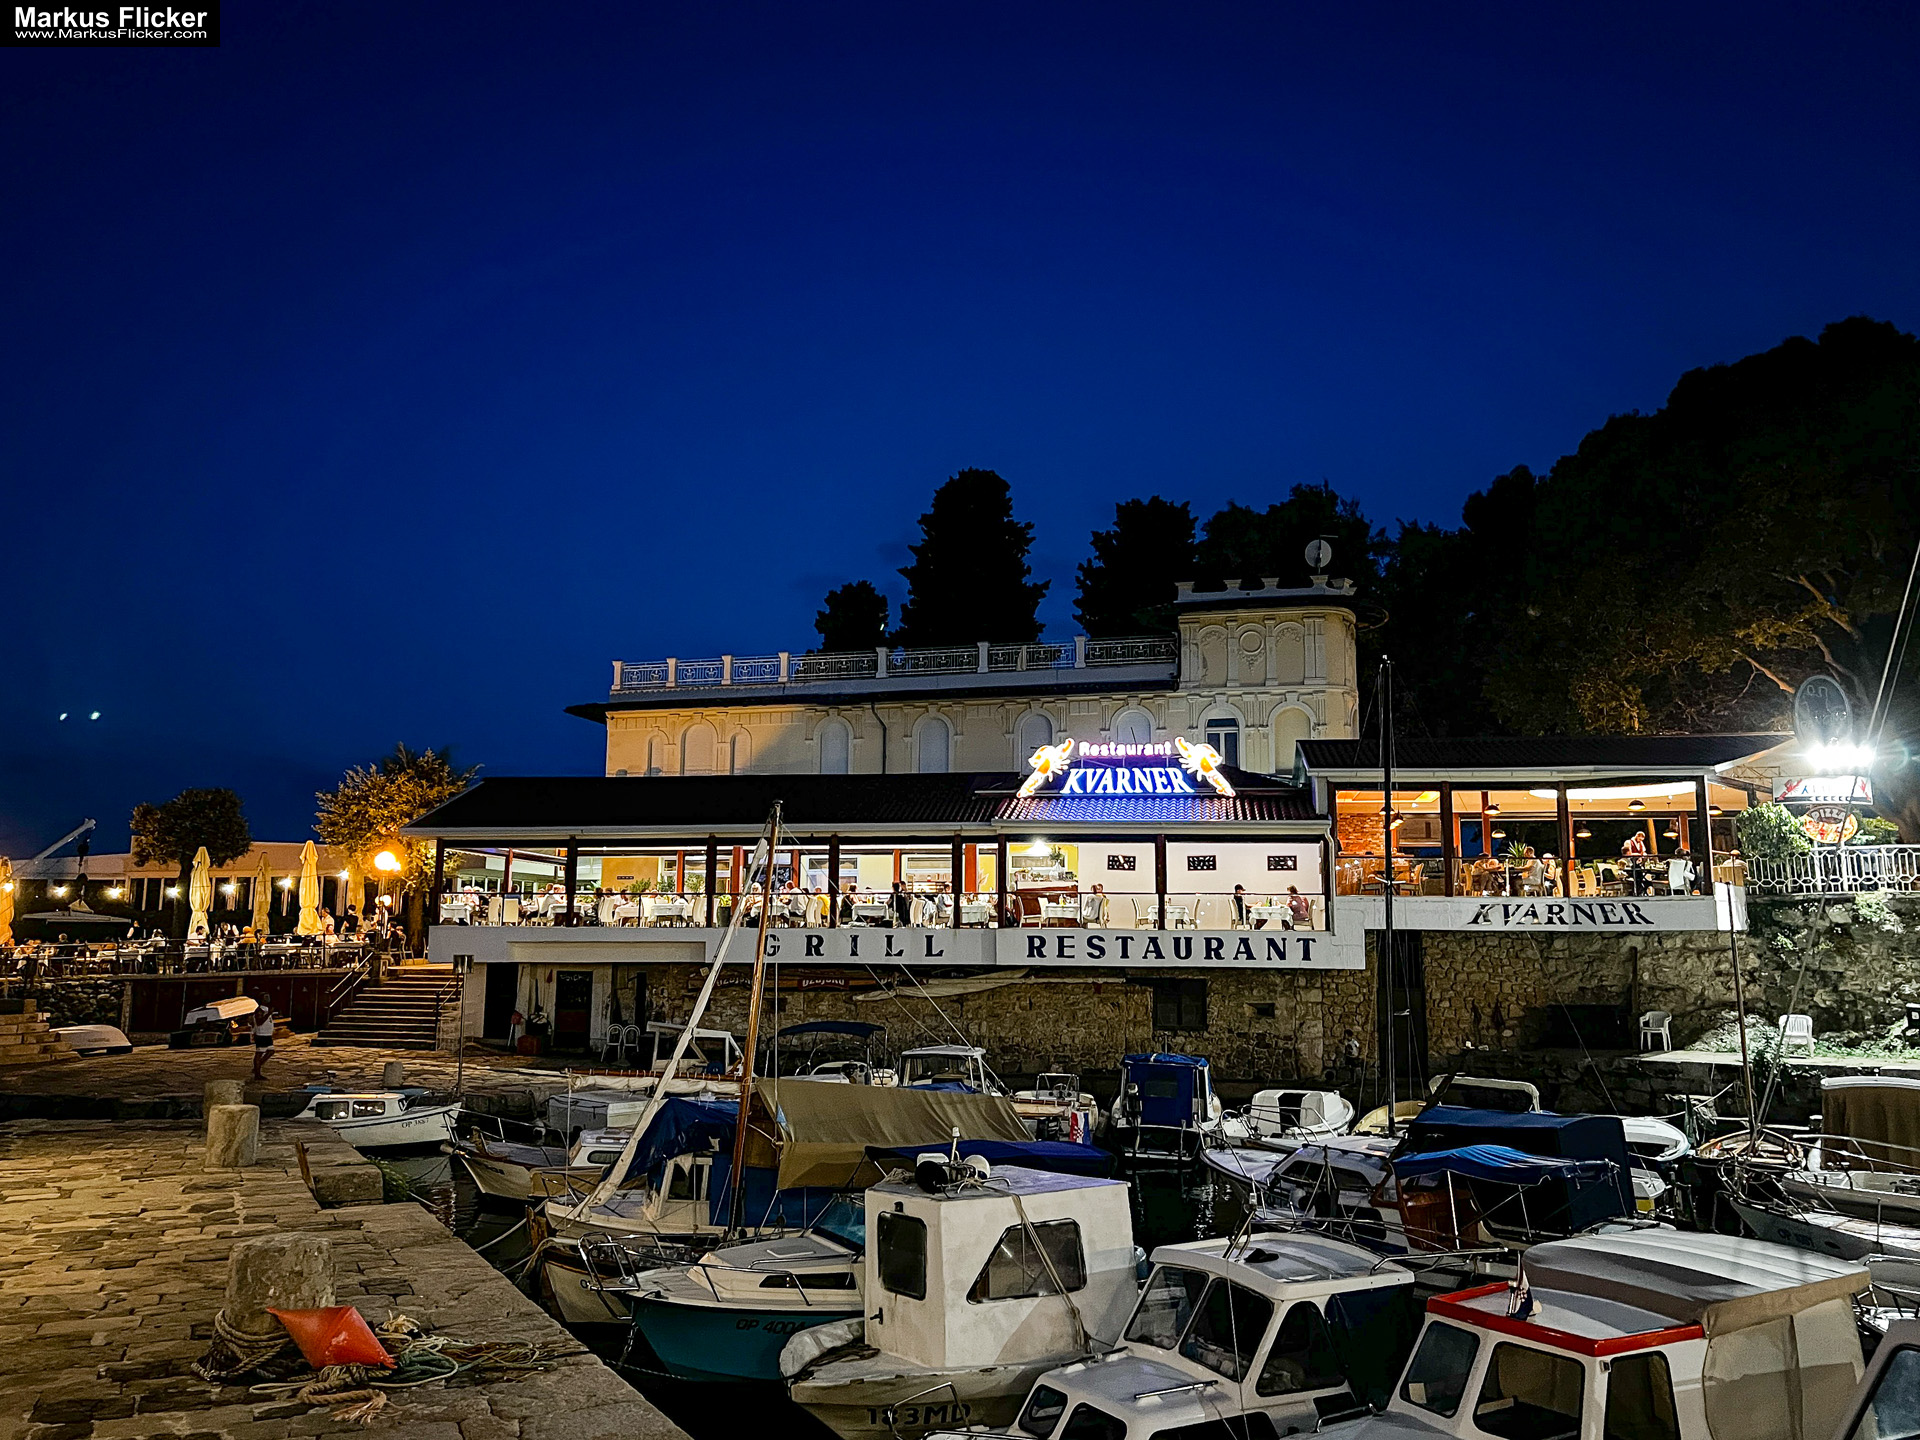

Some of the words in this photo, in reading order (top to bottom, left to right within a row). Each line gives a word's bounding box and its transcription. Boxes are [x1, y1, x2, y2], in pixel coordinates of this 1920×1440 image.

[1079, 741, 1172, 756] Restaurant
[1060, 768, 1195, 793] KVARNER
[1811, 808, 1846, 822] PIZZA
[1467, 903, 1654, 925] KVARNER
[764, 934, 944, 957] GRILL
[1026, 935, 1316, 961] RESTAURANT
[736, 1319, 759, 1331] OP
